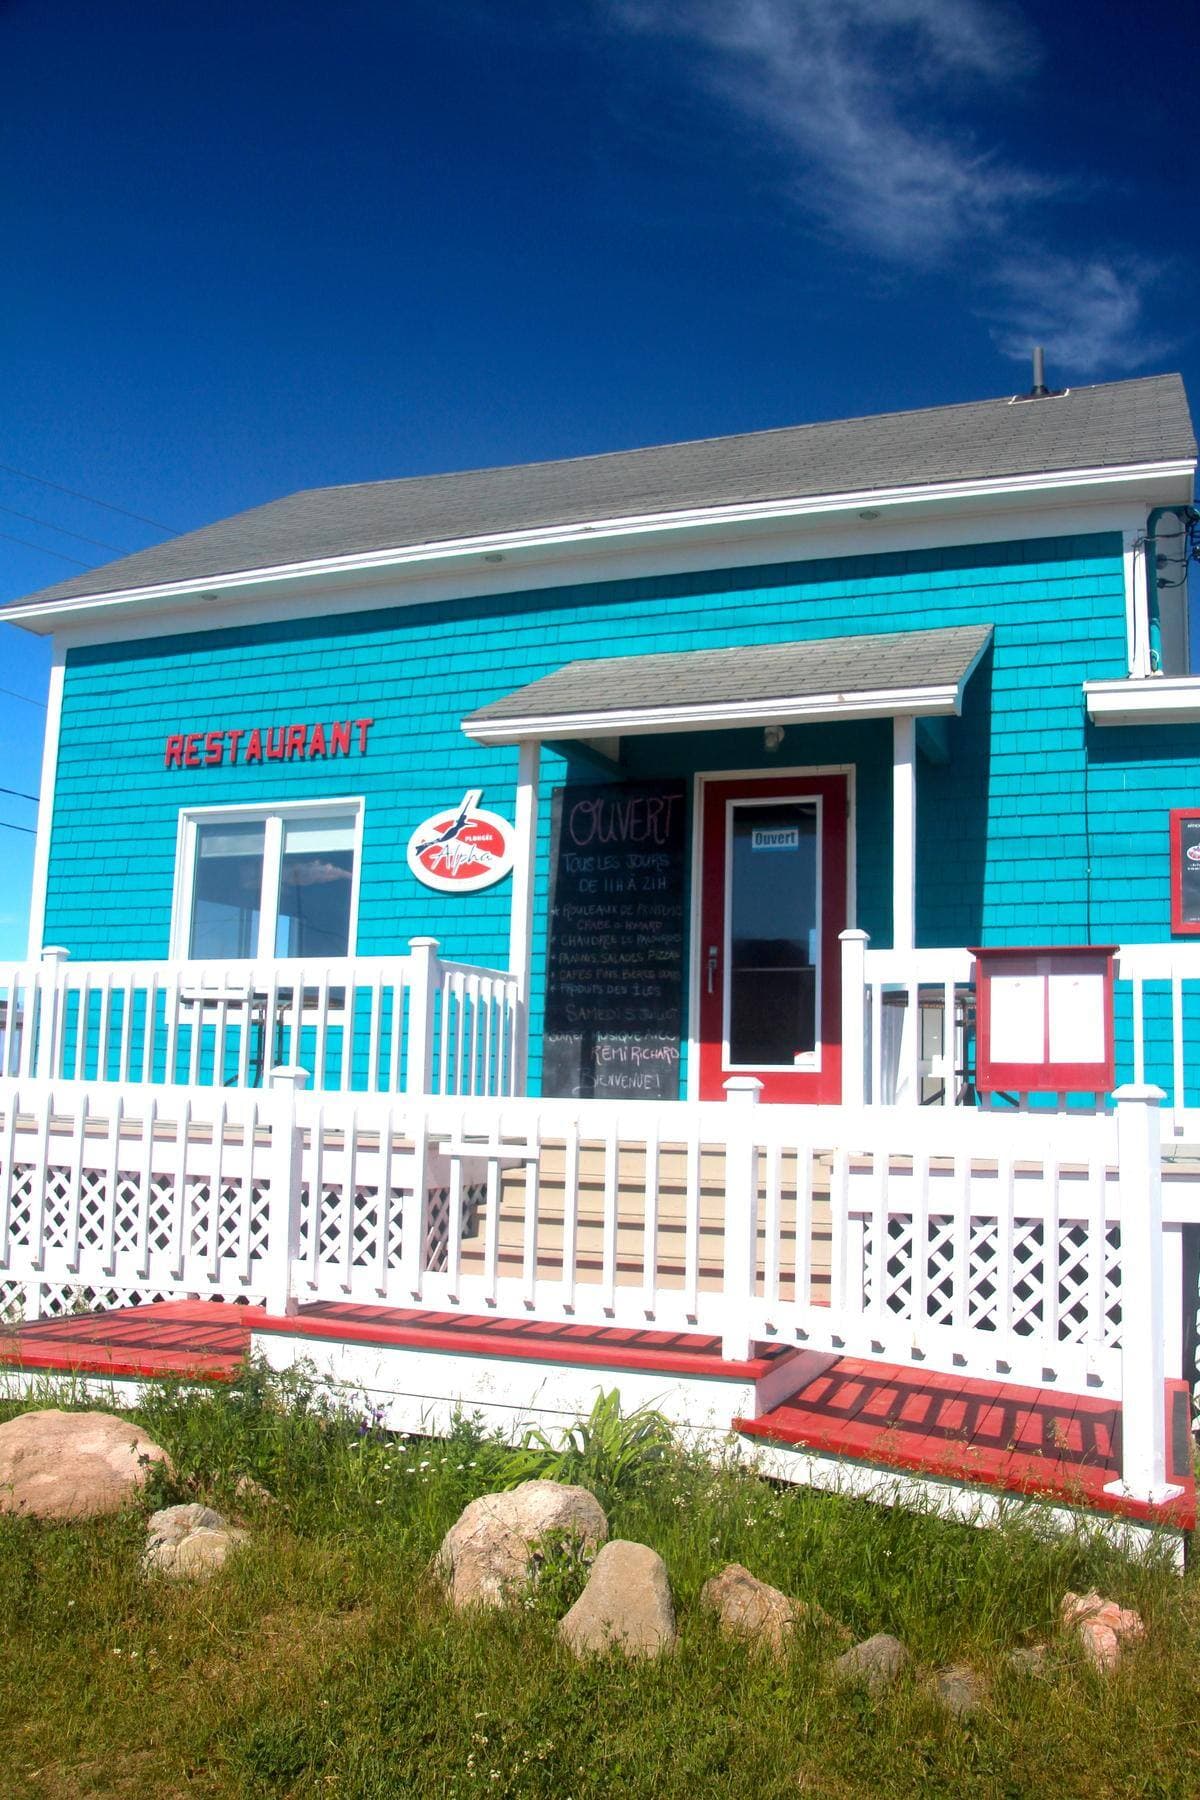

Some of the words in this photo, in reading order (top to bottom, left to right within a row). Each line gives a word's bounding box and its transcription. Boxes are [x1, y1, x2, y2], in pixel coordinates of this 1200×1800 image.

[164, 718, 374, 767] RESTAURANT
[569, 794, 683, 846] OUVERT
[755, 832, 795, 846] Ouvert
[431, 844, 493, 876] Alpha
[597, 855, 620, 870] LES
[578, 878, 599, 893] DE
